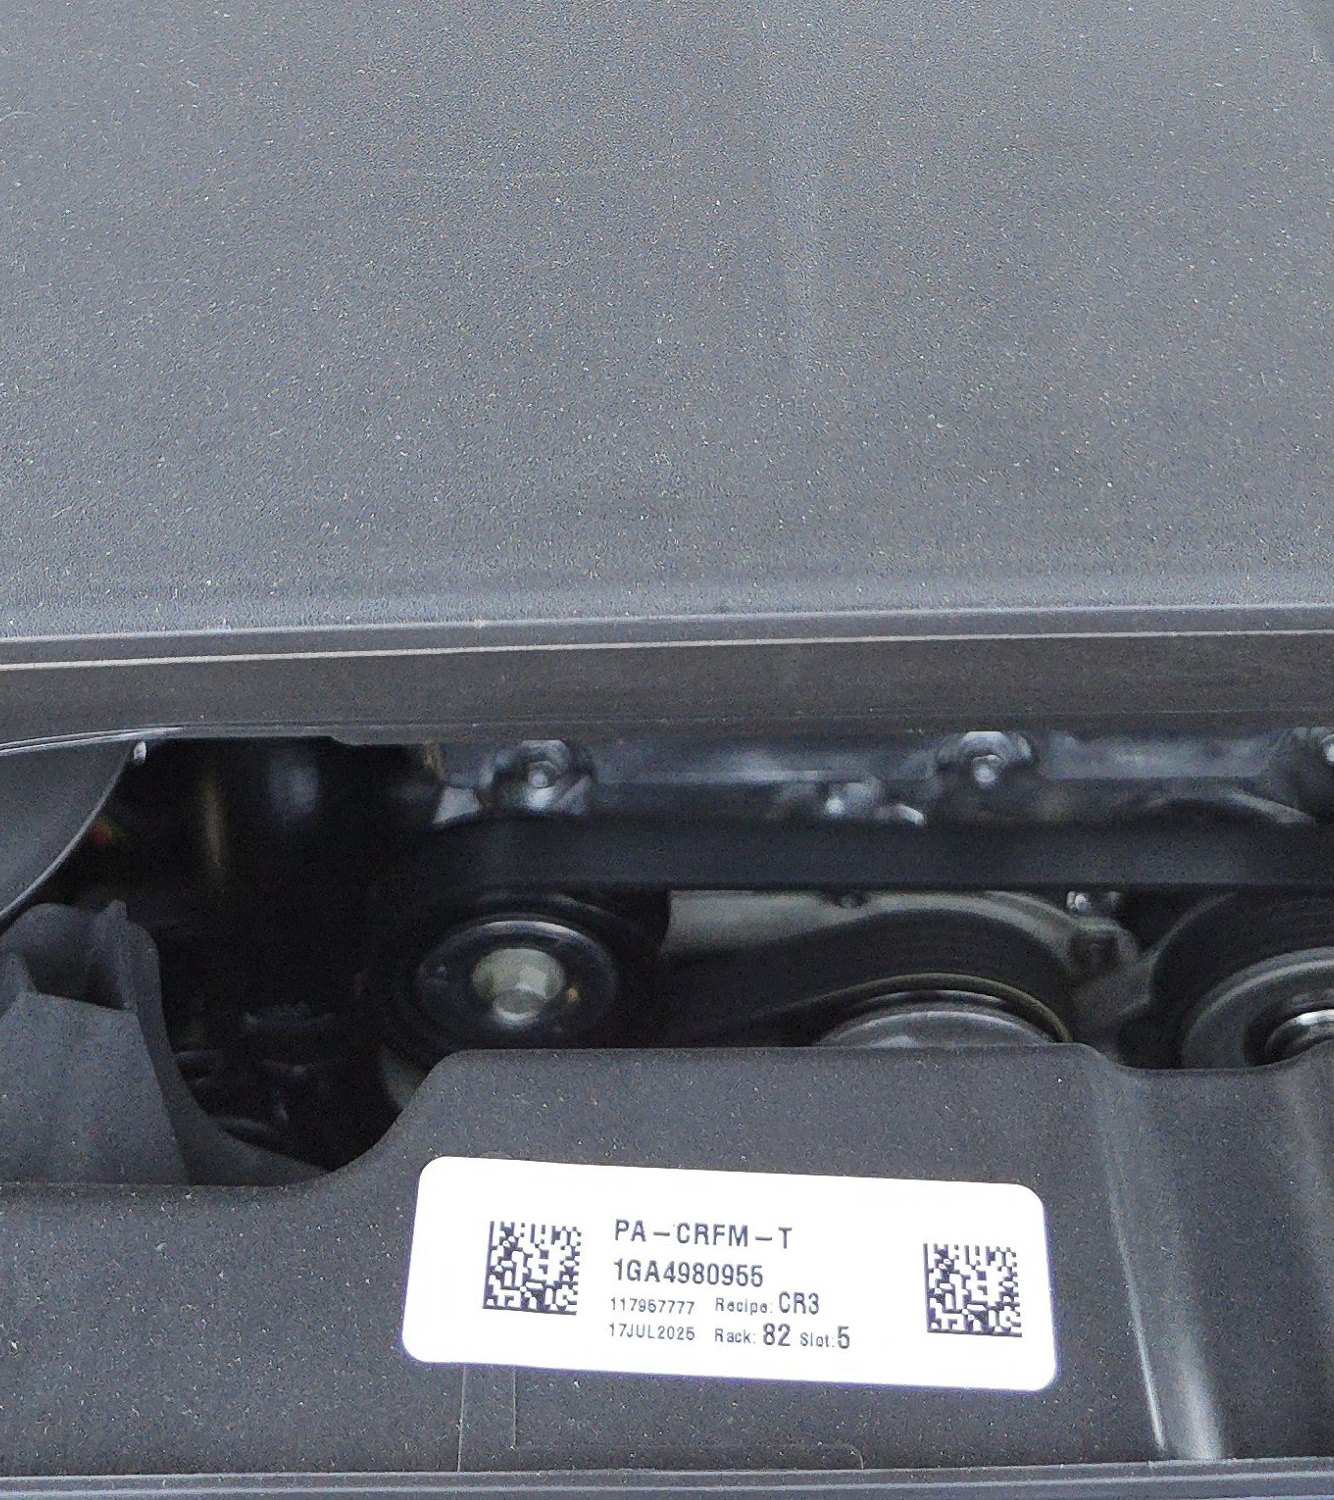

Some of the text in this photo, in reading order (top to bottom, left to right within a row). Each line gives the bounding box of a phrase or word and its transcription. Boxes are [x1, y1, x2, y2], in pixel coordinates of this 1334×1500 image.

[613, 1257, 764, 1288] 1GA4980955
[610, 1291, 820, 1316] 117957777 Recipe: CR3
[609, 1322, 696, 1341] 17JUL2025
[714, 1327, 756, 1345] Rack:
[762, 1322, 792, 1347] 82
